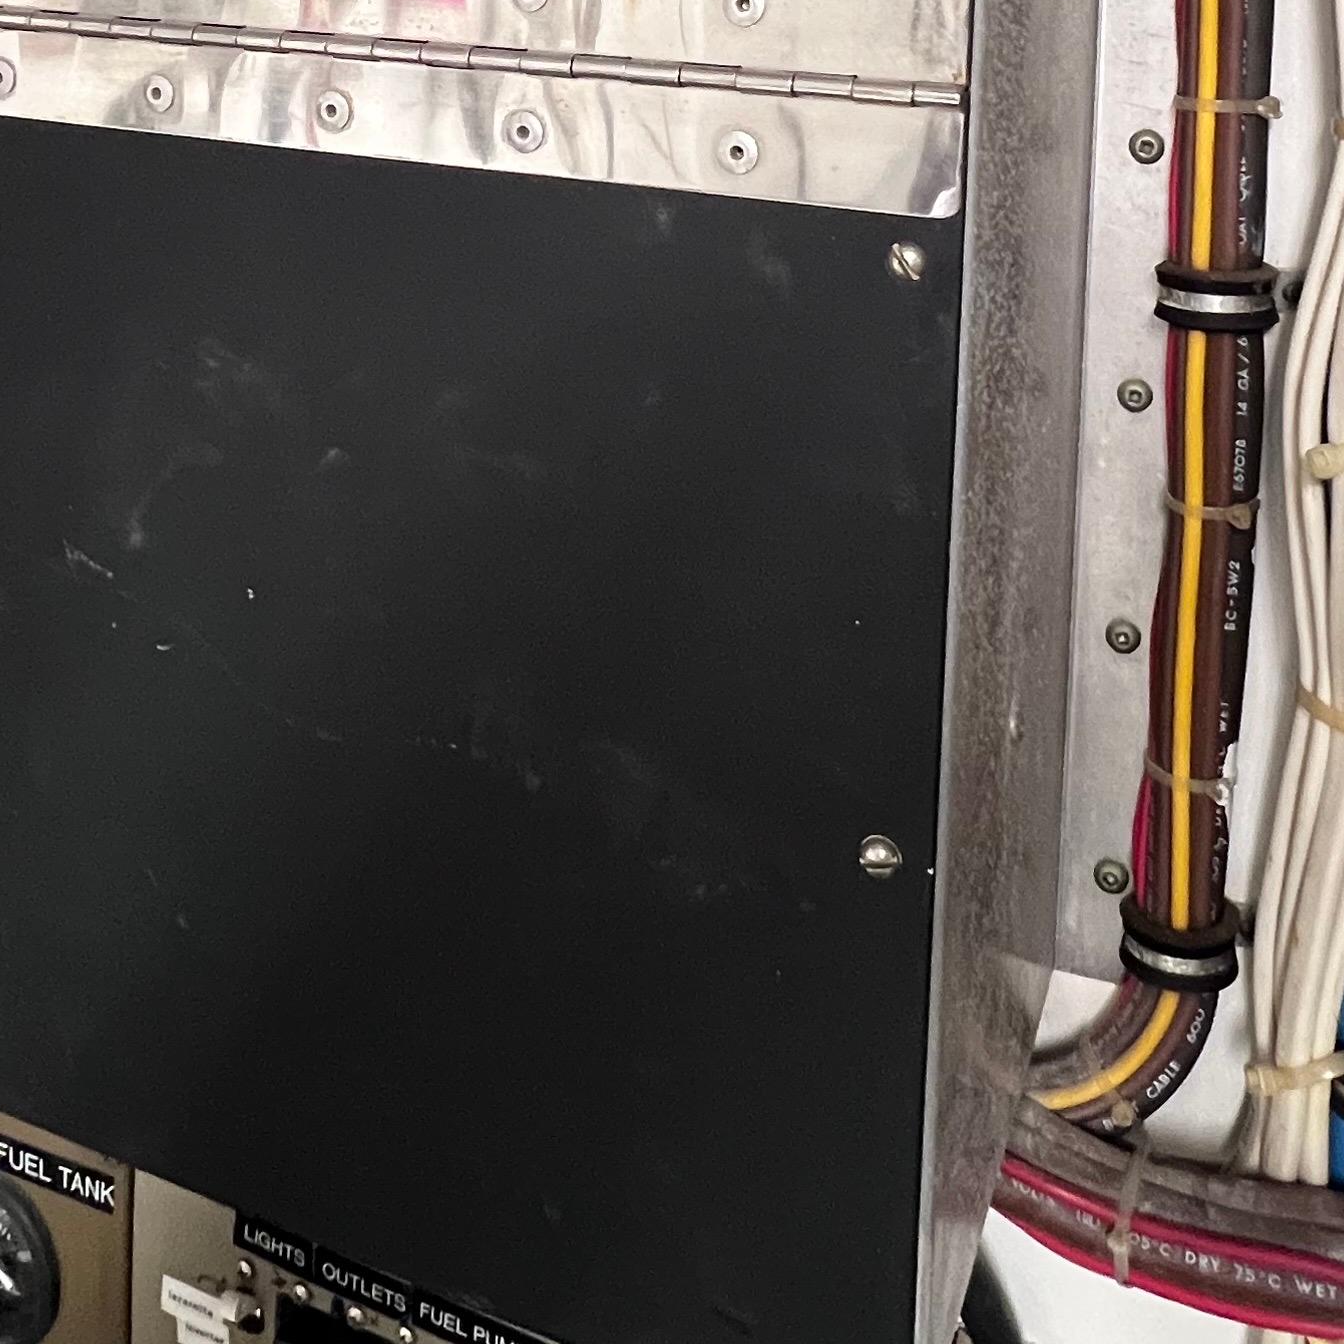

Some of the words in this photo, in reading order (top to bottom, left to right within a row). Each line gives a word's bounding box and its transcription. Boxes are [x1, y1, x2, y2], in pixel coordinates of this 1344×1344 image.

[1146, 1060, 1182, 1099] CABLE
[58, 1165, 115, 1207] TANK
[243, 1223, 306, 1268] LIGHTS
[322, 1262, 406, 1313] OUTLETS
[1184, 1250, 1220, 1274] DRY
[1293, 1275, 1339, 1301] WET
[419, 1301, 468, 1338] FUEL
